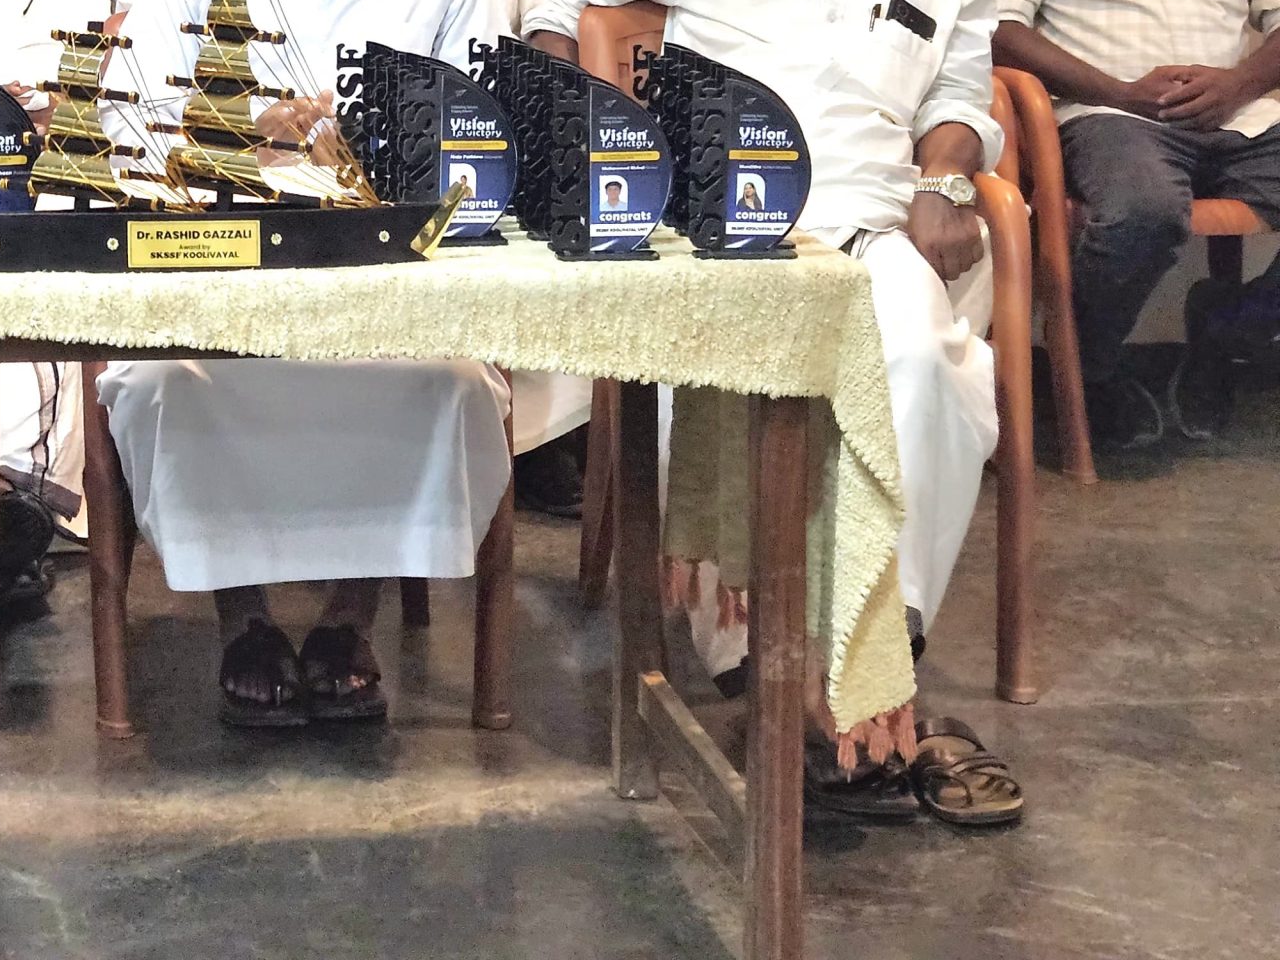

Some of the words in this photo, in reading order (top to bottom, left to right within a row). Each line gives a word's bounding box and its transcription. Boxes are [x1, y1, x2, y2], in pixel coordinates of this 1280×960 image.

[450, 117, 496, 131] Vision
[600, 127, 648, 142] Vision
[739, 126, 787, 140] Vision
[461, 199, 498, 210] ngrats
[599, 211, 652, 222] congrats
[735, 210, 788, 221] congrats
[137, 231, 154, 240] Dr.
[156, 230, 200, 240] RASHID
[203, 230, 252, 239] GAZZALI
[183, 251, 239, 259] KOOLIVAYAL
